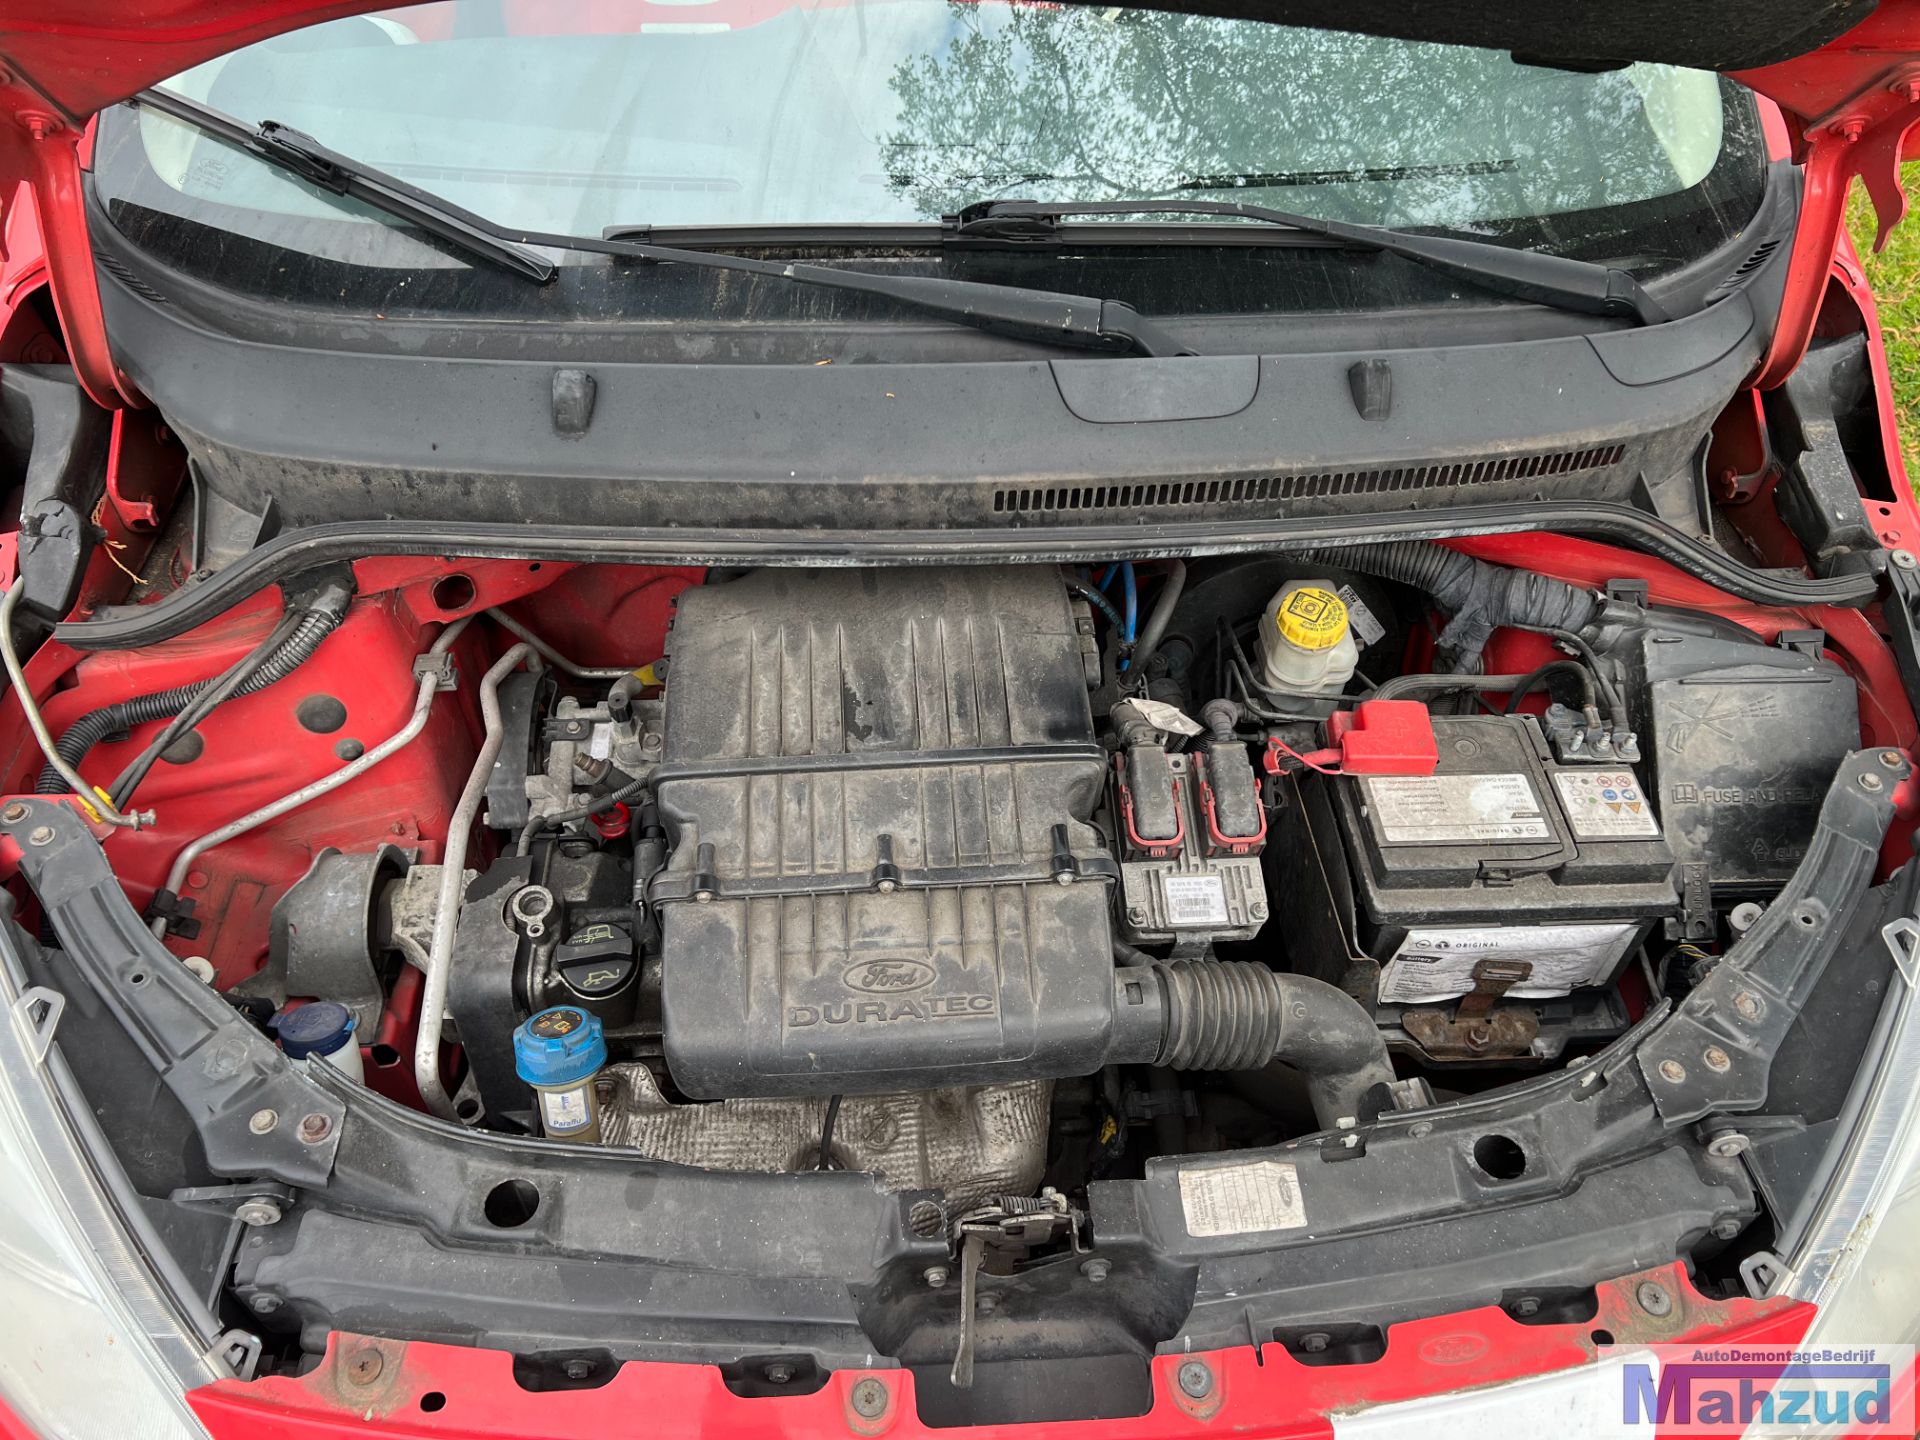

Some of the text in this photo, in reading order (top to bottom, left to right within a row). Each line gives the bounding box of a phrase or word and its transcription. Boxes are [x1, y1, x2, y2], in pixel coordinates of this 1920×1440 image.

[1703, 790, 1741, 803] FUSE
[1748, 789, 1777, 802] AND
[1455, 941, 1500, 949] ORIGINAL
[861, 962, 917, 988] Ford
[788, 995, 994, 1027] DURATEC
